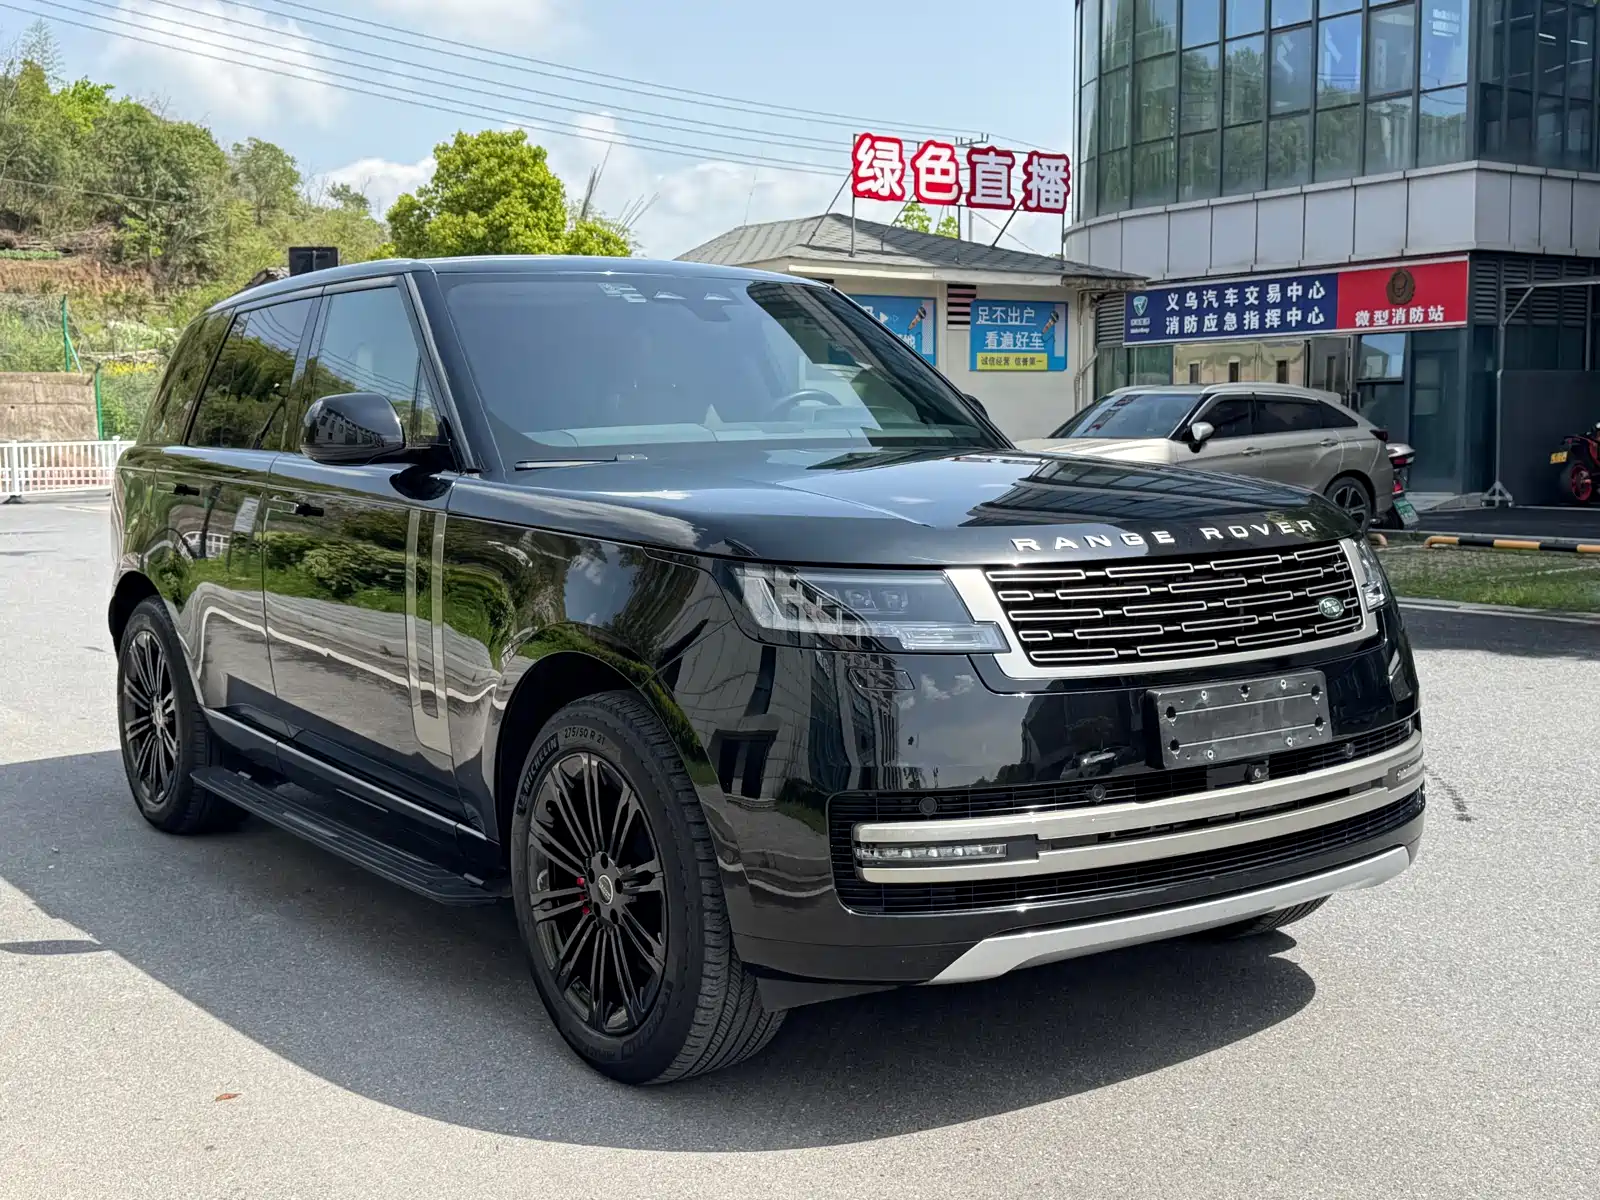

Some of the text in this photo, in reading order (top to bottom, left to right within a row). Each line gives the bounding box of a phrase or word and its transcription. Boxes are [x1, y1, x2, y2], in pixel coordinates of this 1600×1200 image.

[853, 135, 1069, 211] 绿色直播
[1165, 280, 1326, 312] 义乌汽车交易中心
[976, 306, 1036, 325] 足不出户
[1165, 306, 1326, 336] 消防应急指挥中心
[1355, 306, 1445, 327] 微型消防站
[984, 331, 1044, 350] 看遍好车
[1011, 518, 1318, 552] RANGE ROVER
[524, 727, 606, 793] MICHELIN 275/50 R 21
